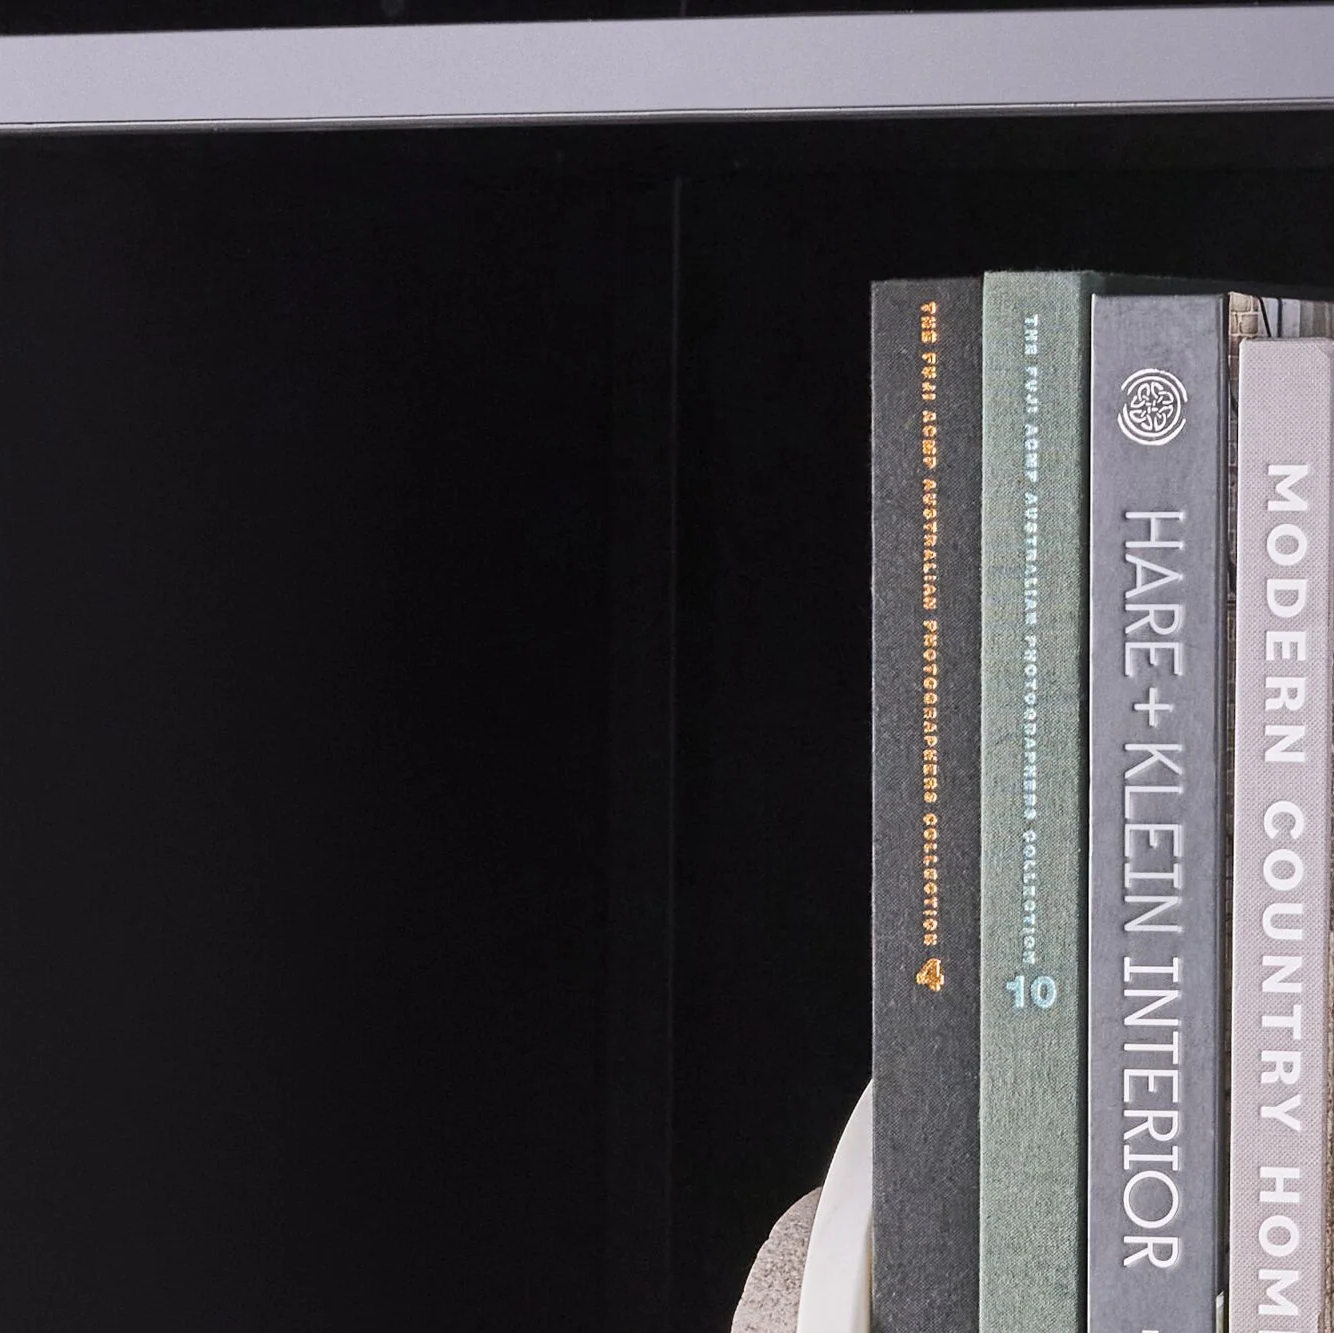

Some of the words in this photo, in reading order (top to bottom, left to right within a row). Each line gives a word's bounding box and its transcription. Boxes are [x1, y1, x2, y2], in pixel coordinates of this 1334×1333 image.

[920, 301, 938, 344] THE
[921, 353, 938, 400] FUJI
[1023, 314, 1039, 356] THE
[921, 410, 938, 470] ACMP
[1023, 366, 1039, 415] FUJI
[1023, 423, 1039, 483] ACMP
[921, 479, 938, 611] AUSTRALIAN
[1023, 493, 1039, 626] AUSTRALIAN
[1125, 511, 1185, 676] HARE
[1264, 464, 1309, 763] MODERN
[922, 620, 939, 803] PHOTOGRAPHERS
[1022, 635, 1038, 820] PHOTOGRAPHERS
[1134, 688, 1171, 727] +
[922, 813, 939, 946] COLLECTION
[1021, 830, 1038, 965] COLLECTION
[1124, 743, 1183, 933] KLEIN
[915, 958, 945, 992] 4
[1006, 974, 1058, 1010] 10
[1260, 801, 1306, 1131] COUNTRY
[1123, 957, 1181, 1269] INTERIOR
